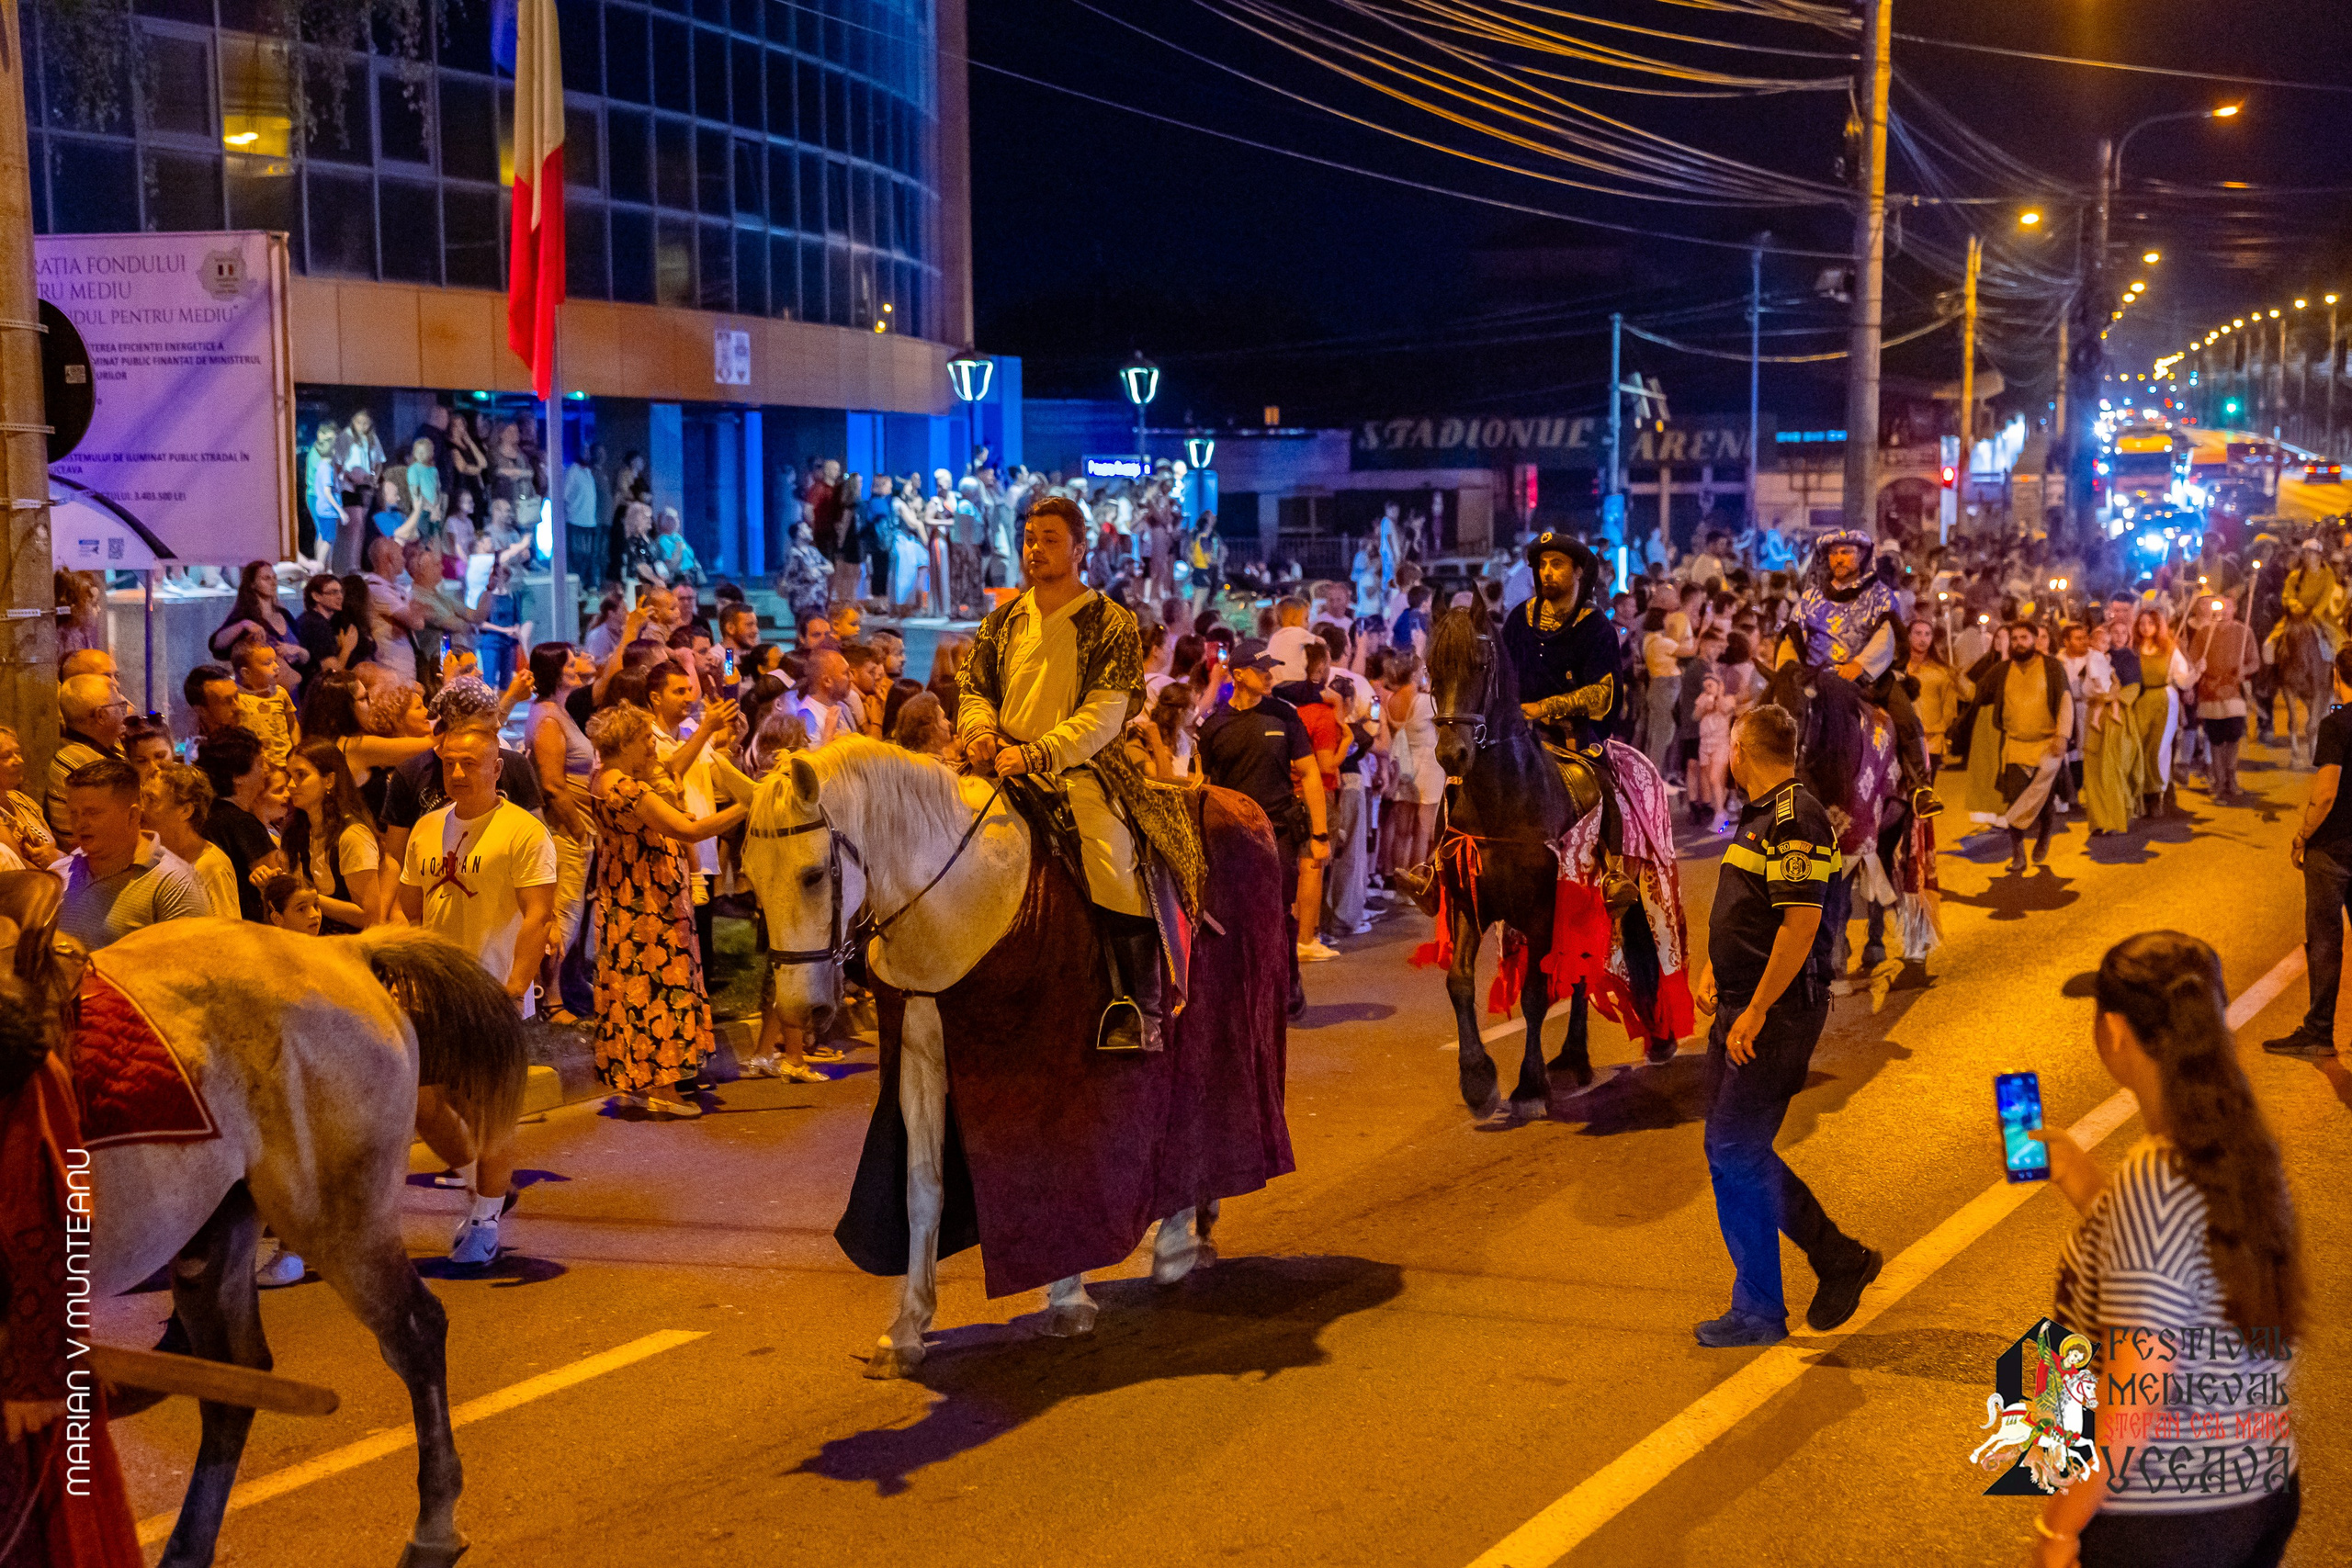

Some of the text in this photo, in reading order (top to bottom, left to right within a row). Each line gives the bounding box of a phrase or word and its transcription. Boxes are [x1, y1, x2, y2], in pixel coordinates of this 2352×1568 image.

[86, 254, 186, 275] FONDULUI
[70, 280, 132, 300] MEDIU
[110, 308, 174, 323] PENTRU
[121, 356, 151, 367] PUBLIC
[196, 355, 208, 366] DE
[209, 355, 262, 366] MINISTERUL
[112, 452, 123, 462] DE
[126, 452, 166, 462] ILUMINAT
[169, 452, 198, 462] PUBLIC
